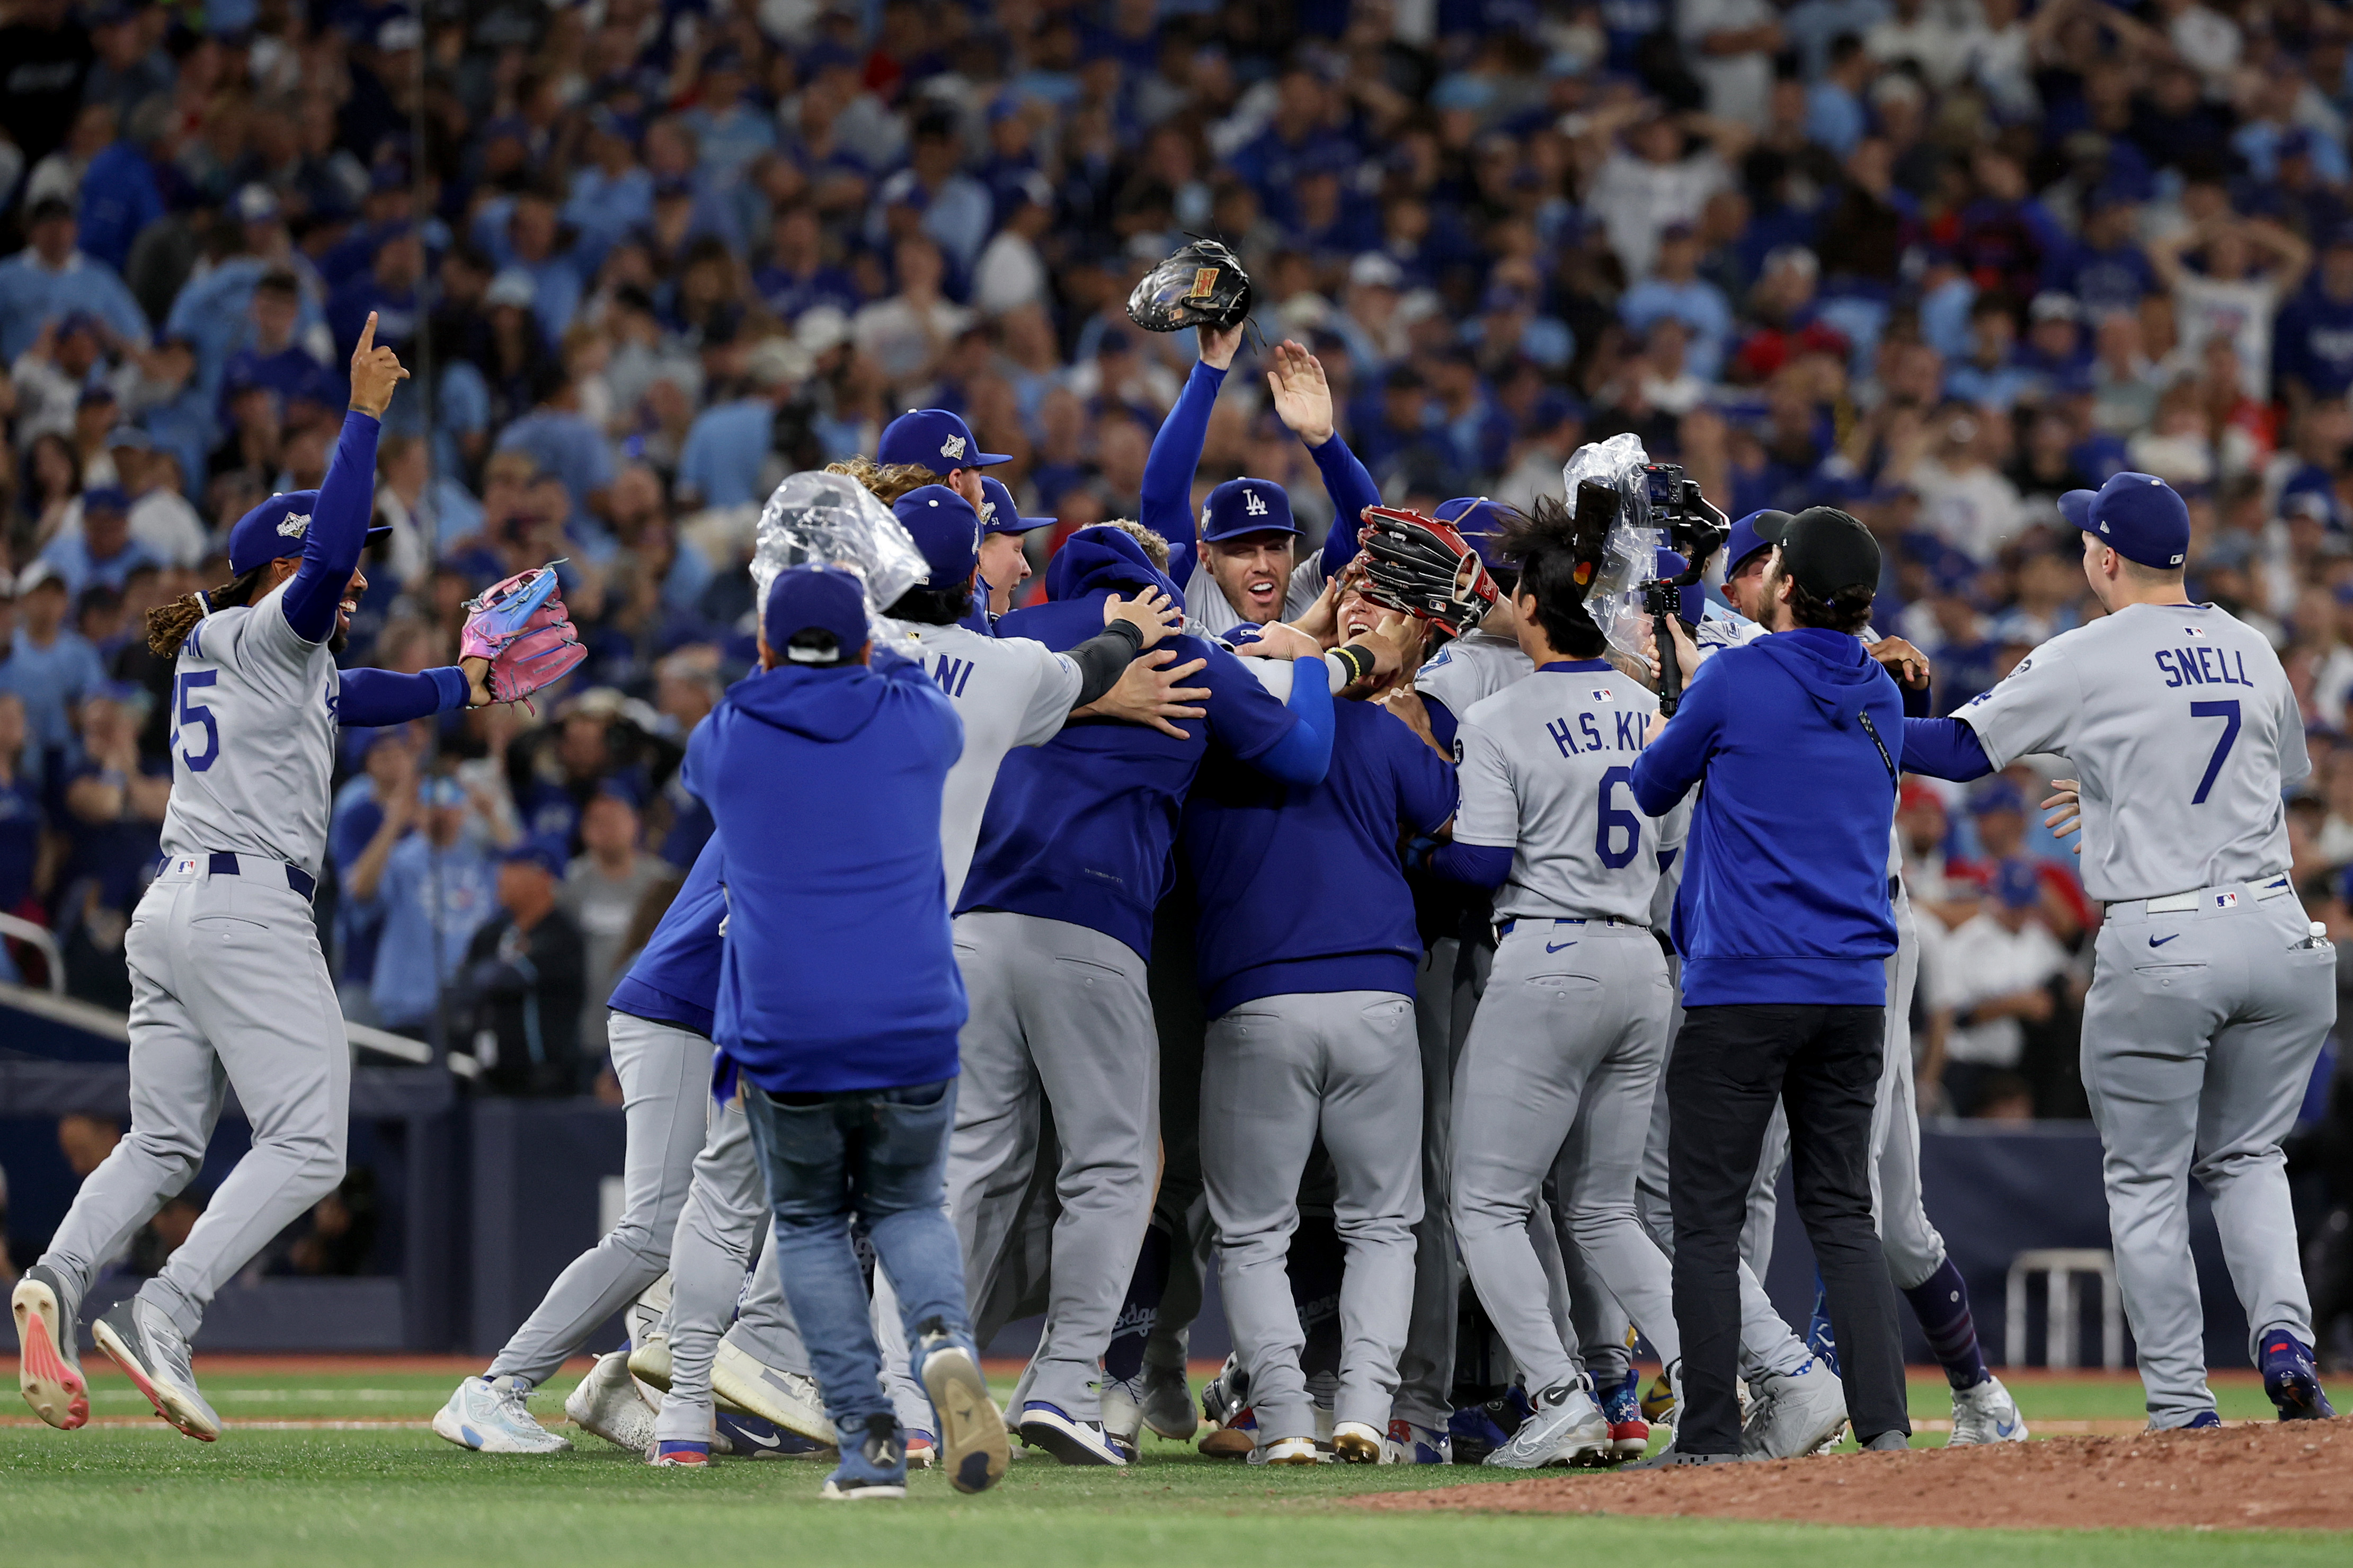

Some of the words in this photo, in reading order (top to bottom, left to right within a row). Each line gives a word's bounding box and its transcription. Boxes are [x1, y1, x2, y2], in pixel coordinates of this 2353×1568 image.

[991, 517, 1000, 525] 51
[1242, 489, 1268, 515] LA
[2155, 647, 2254, 688] SNELL
[1546, 712, 1610, 759] H.S.
[2190, 700, 2241, 805] 7
[1595, 766, 1641, 869] 6
